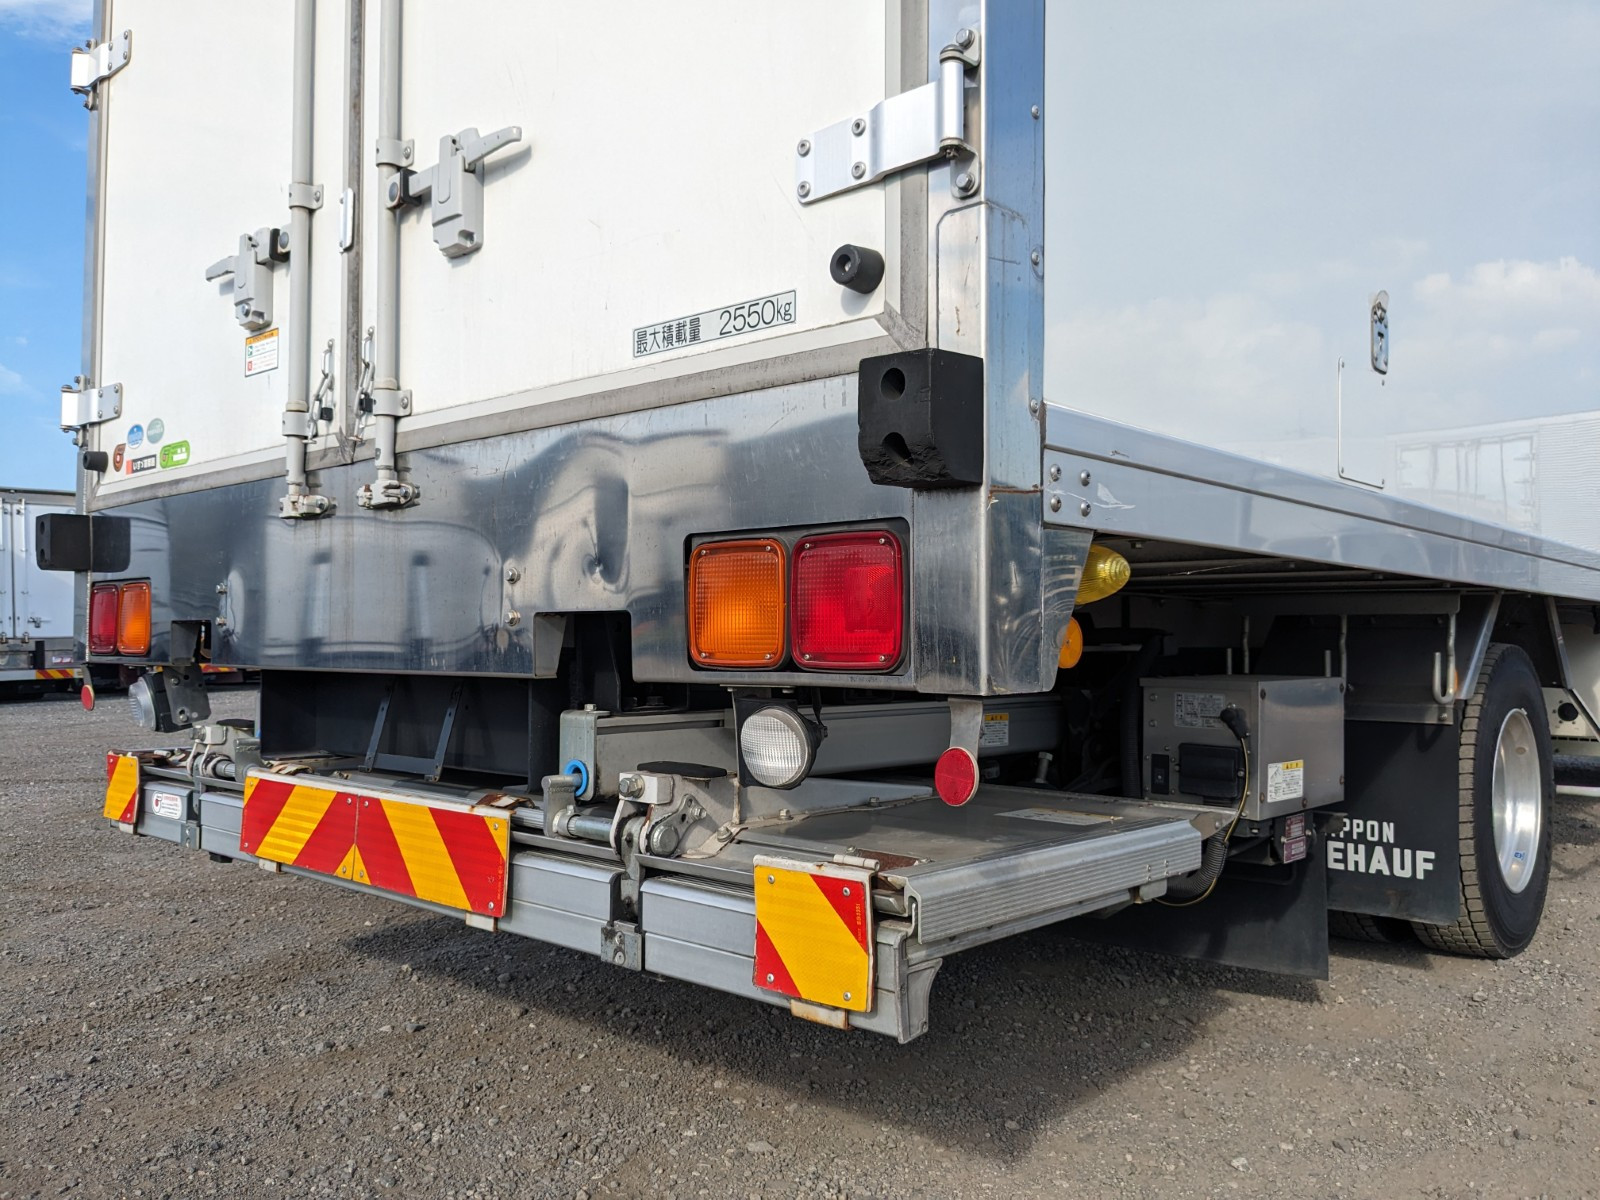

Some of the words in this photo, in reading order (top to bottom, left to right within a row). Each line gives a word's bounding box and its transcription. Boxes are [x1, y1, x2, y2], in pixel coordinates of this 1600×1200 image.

[636, 317, 701, 355] 最大積載量
[719, 298, 793, 336] 2550kg
[1331, 818, 1394, 844] PPON
[1327, 840, 1436, 880] EHAUF
